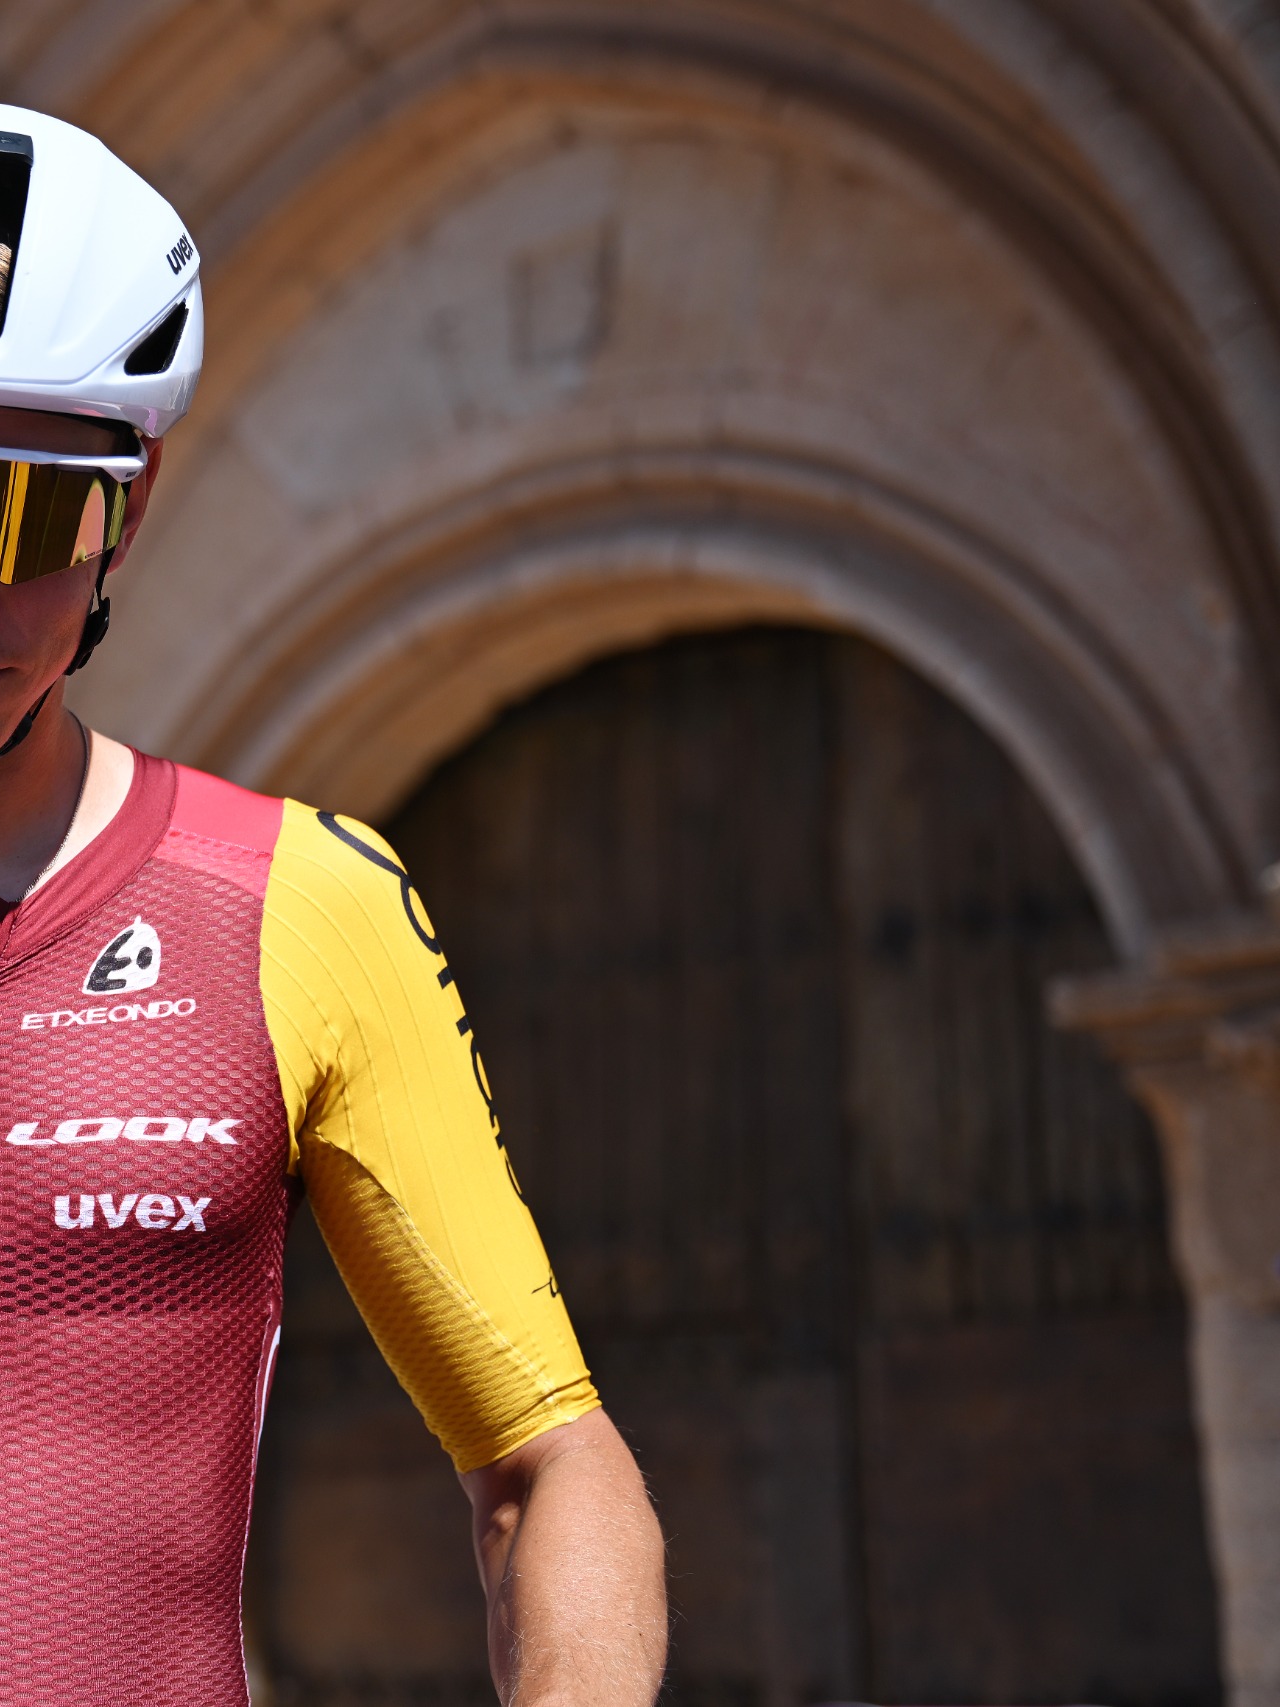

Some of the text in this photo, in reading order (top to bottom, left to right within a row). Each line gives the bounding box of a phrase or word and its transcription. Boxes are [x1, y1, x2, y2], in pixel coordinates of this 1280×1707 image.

[166, 232, 194, 275] uvex
[21, 998, 196, 1030] ETXEONDO
[6, 1116, 245, 1146] LOOK
[54, 1193, 212, 1232] uvex
